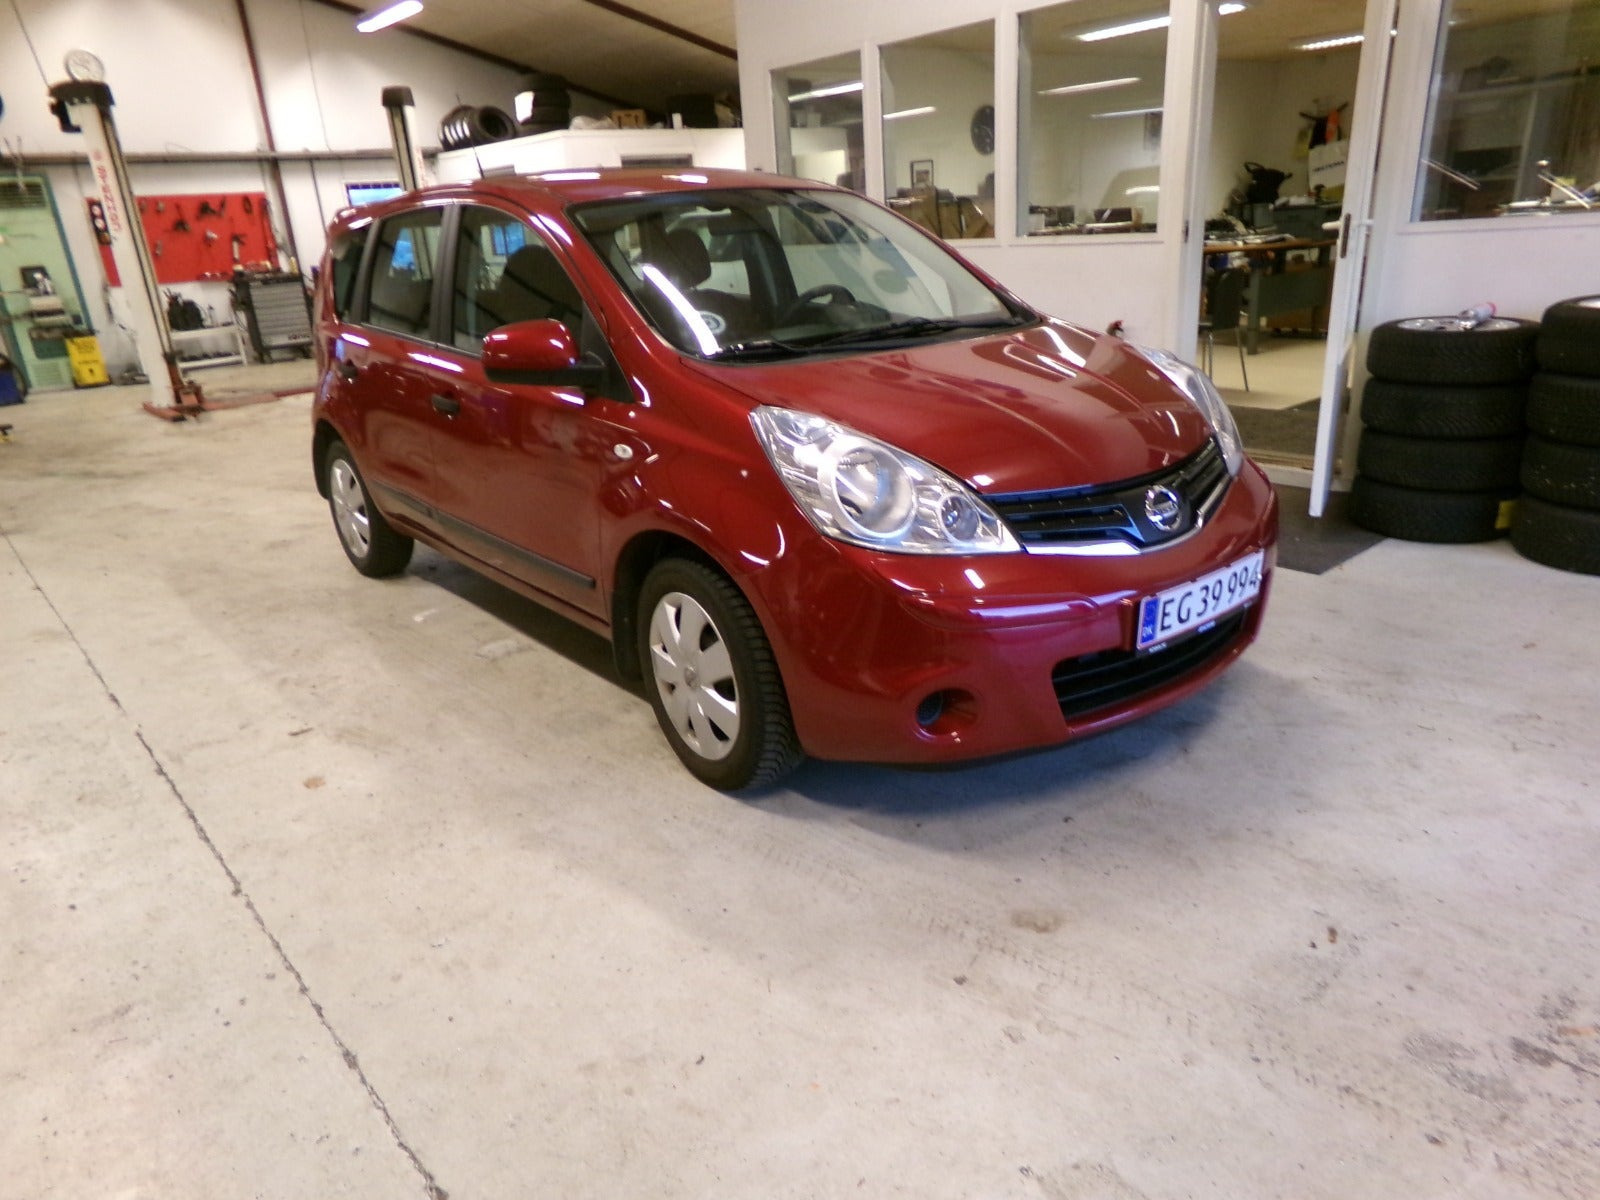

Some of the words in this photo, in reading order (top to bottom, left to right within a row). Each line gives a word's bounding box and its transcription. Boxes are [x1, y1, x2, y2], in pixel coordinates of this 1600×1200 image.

[1160, 591, 1192, 631] EG
[1197, 579, 1223, 617] 39
[1227, 559, 1262, 598] 994
